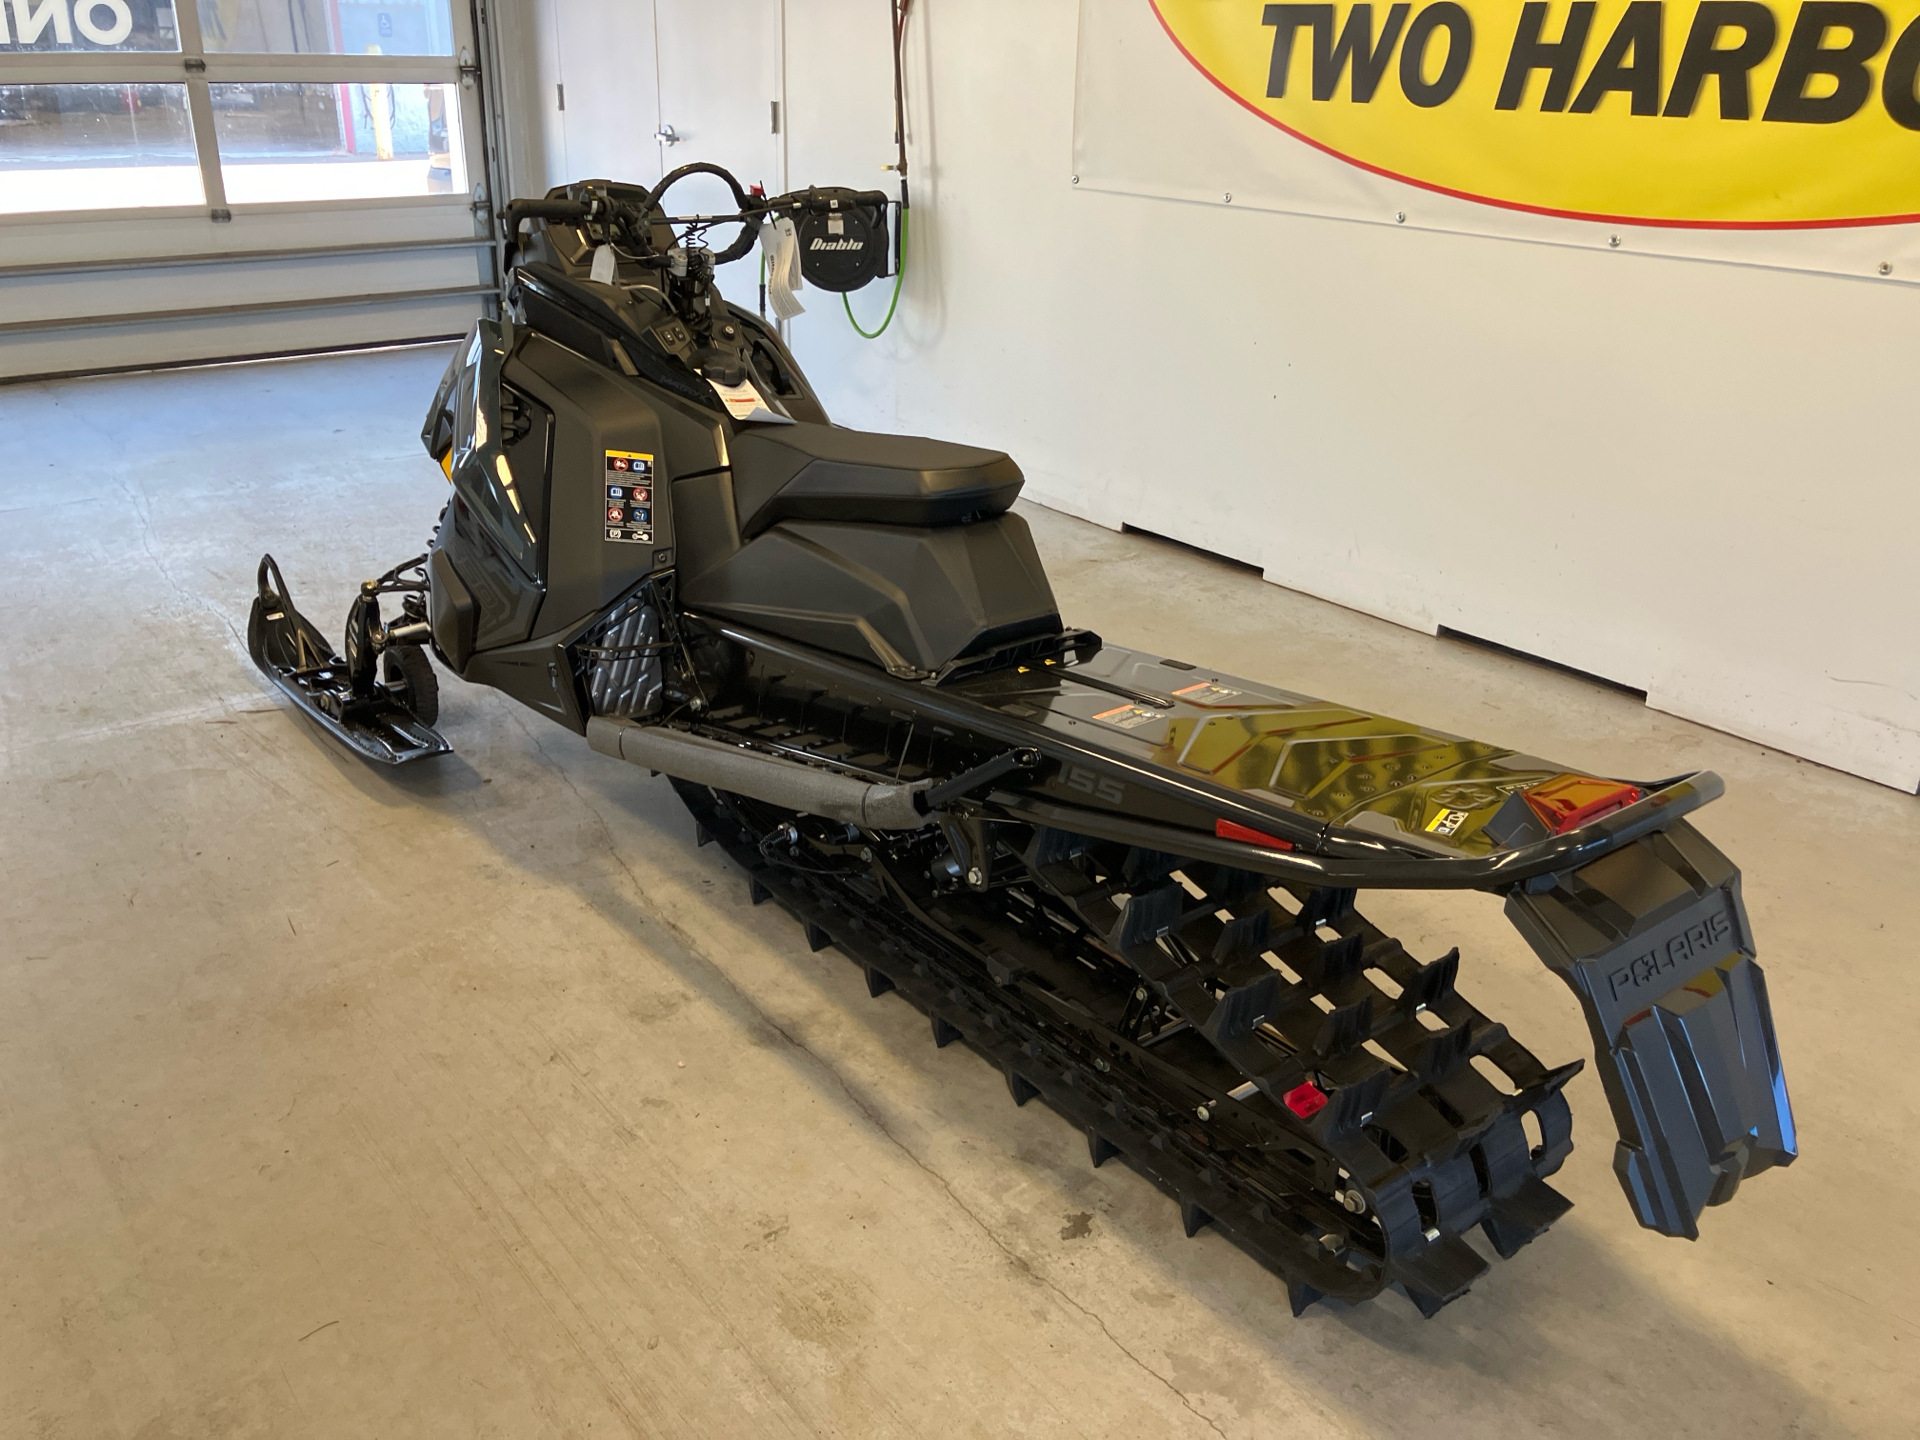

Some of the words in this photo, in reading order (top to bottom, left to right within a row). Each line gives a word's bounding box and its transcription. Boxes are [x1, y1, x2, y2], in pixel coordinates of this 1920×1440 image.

[1260, 1, 1473, 108] TWO
[809, 237, 864, 251] Diablo
[1057, 760, 1127, 805] 155
[1607, 909, 1730, 1002] POLARIS
